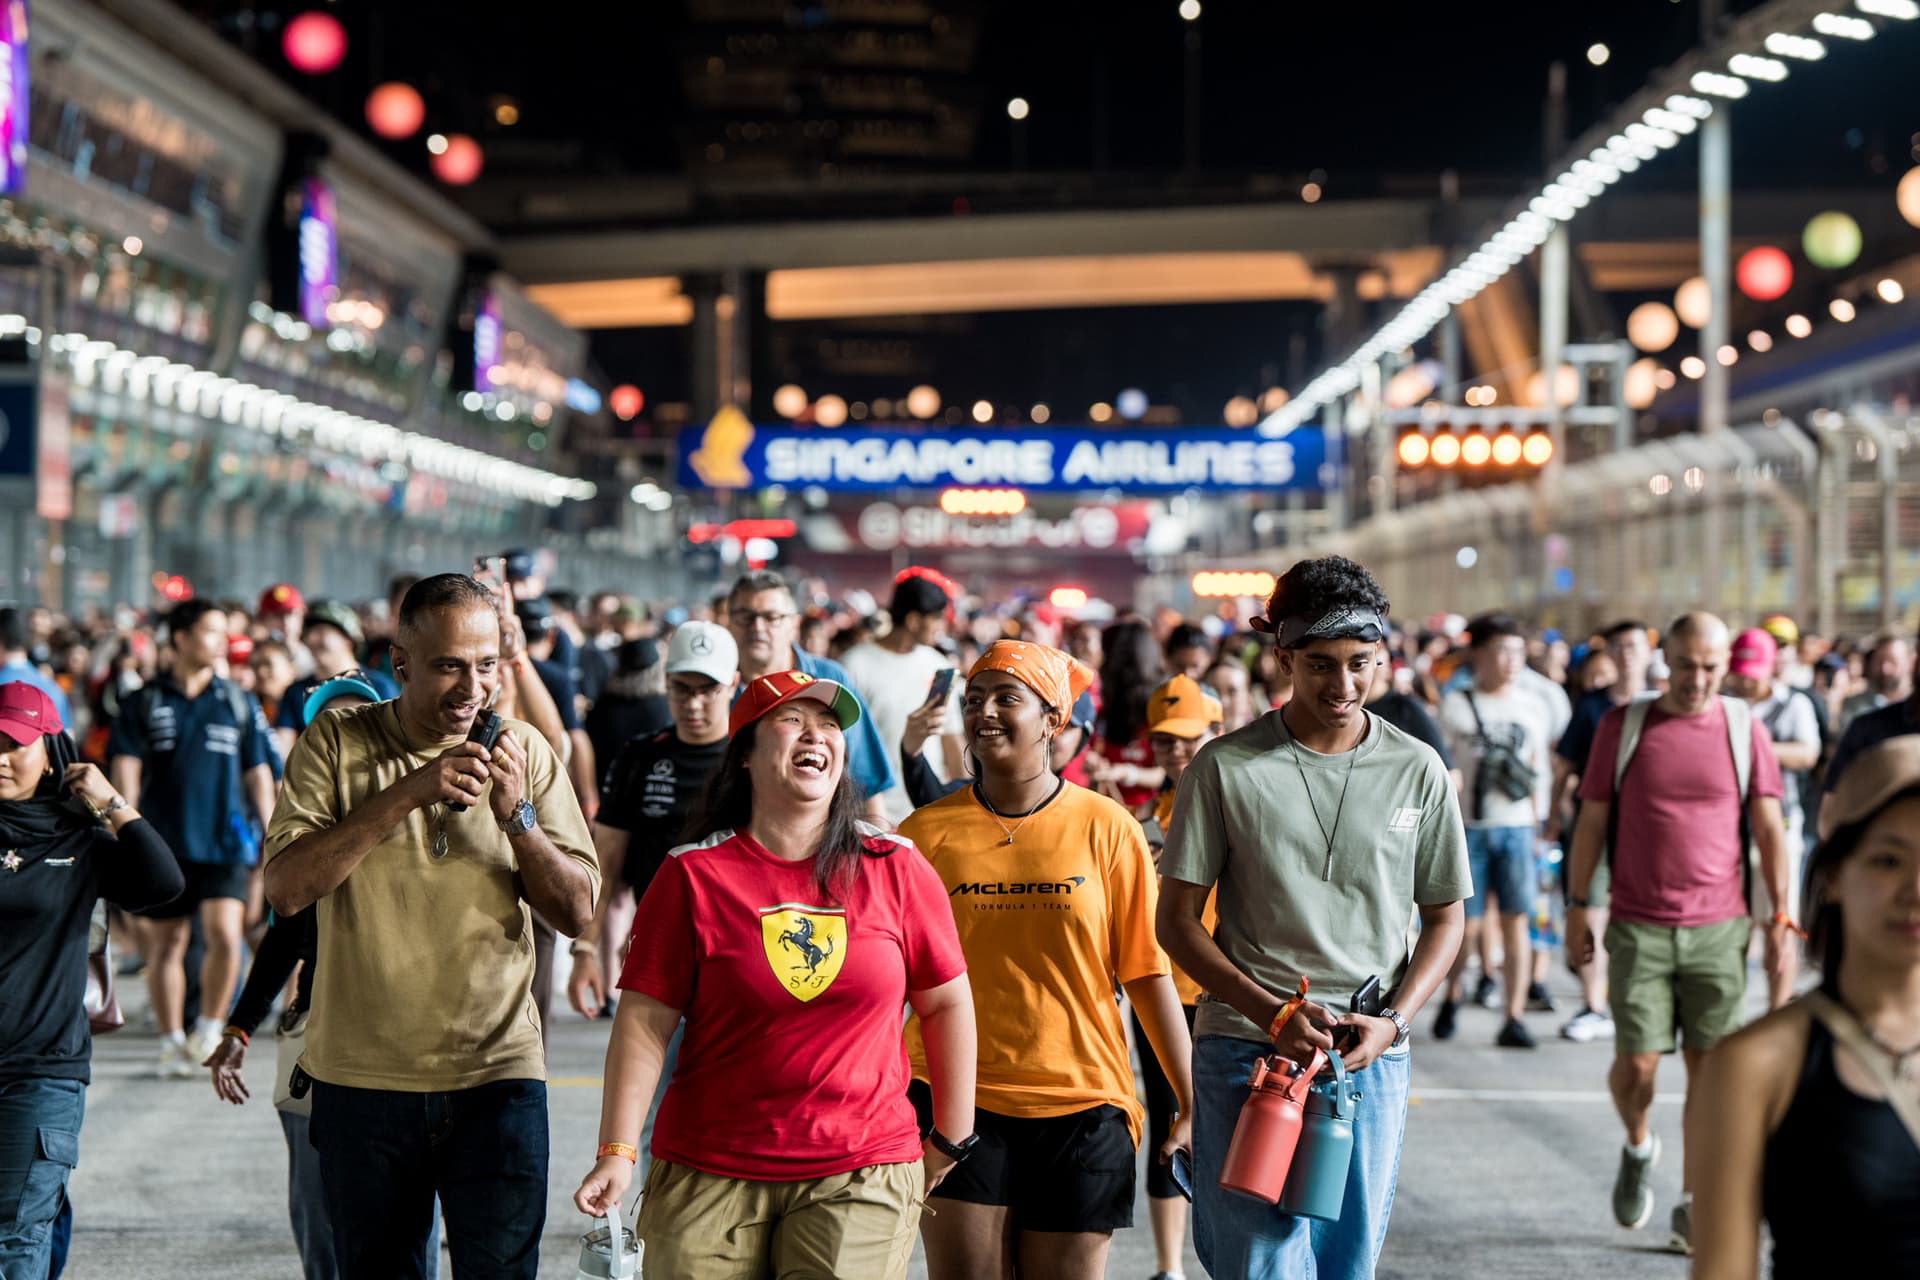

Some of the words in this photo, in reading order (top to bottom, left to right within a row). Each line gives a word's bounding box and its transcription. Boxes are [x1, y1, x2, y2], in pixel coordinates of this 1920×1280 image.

[765, 438, 1054, 484] SINGAPORE
[1062, 440, 1295, 484] AIRLINES
[949, 882, 1071, 896] McLaren
[974, 903, 1025, 911] FORMULA
[1043, 903, 1071, 911] TEAM
